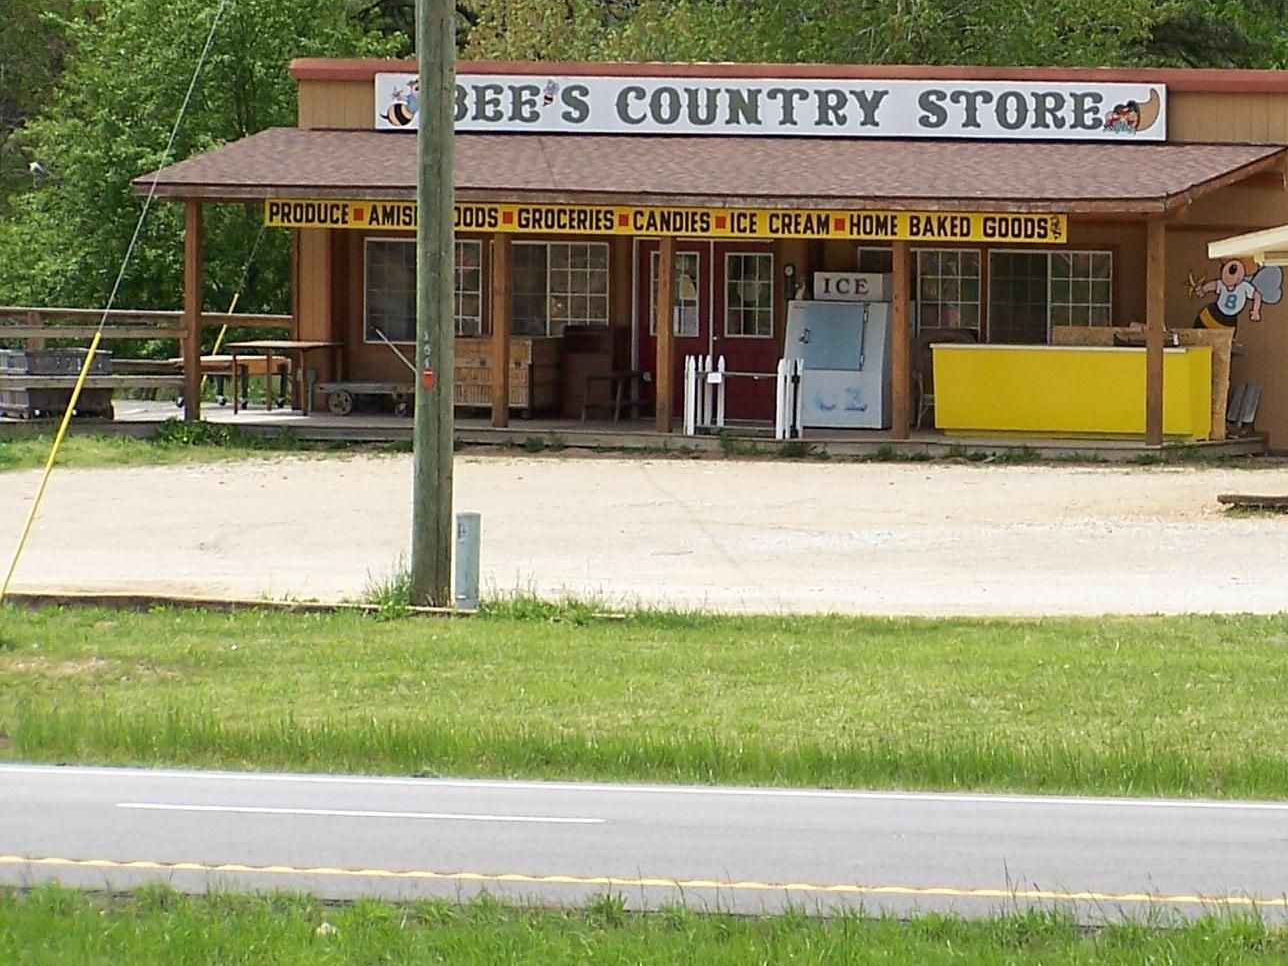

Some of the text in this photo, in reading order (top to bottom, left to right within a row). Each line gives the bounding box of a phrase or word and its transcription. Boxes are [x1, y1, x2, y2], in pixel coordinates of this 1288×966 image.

[615, 85, 889, 127] COUNTRY
[917, 88, 1104, 130] STORE
[268, 202, 1049, 239] PRODUCE AMIS OODS GROCERIES CANDIES ICE CREAM HOME BAKED GOODS
[823, 277, 870, 295] ICE
